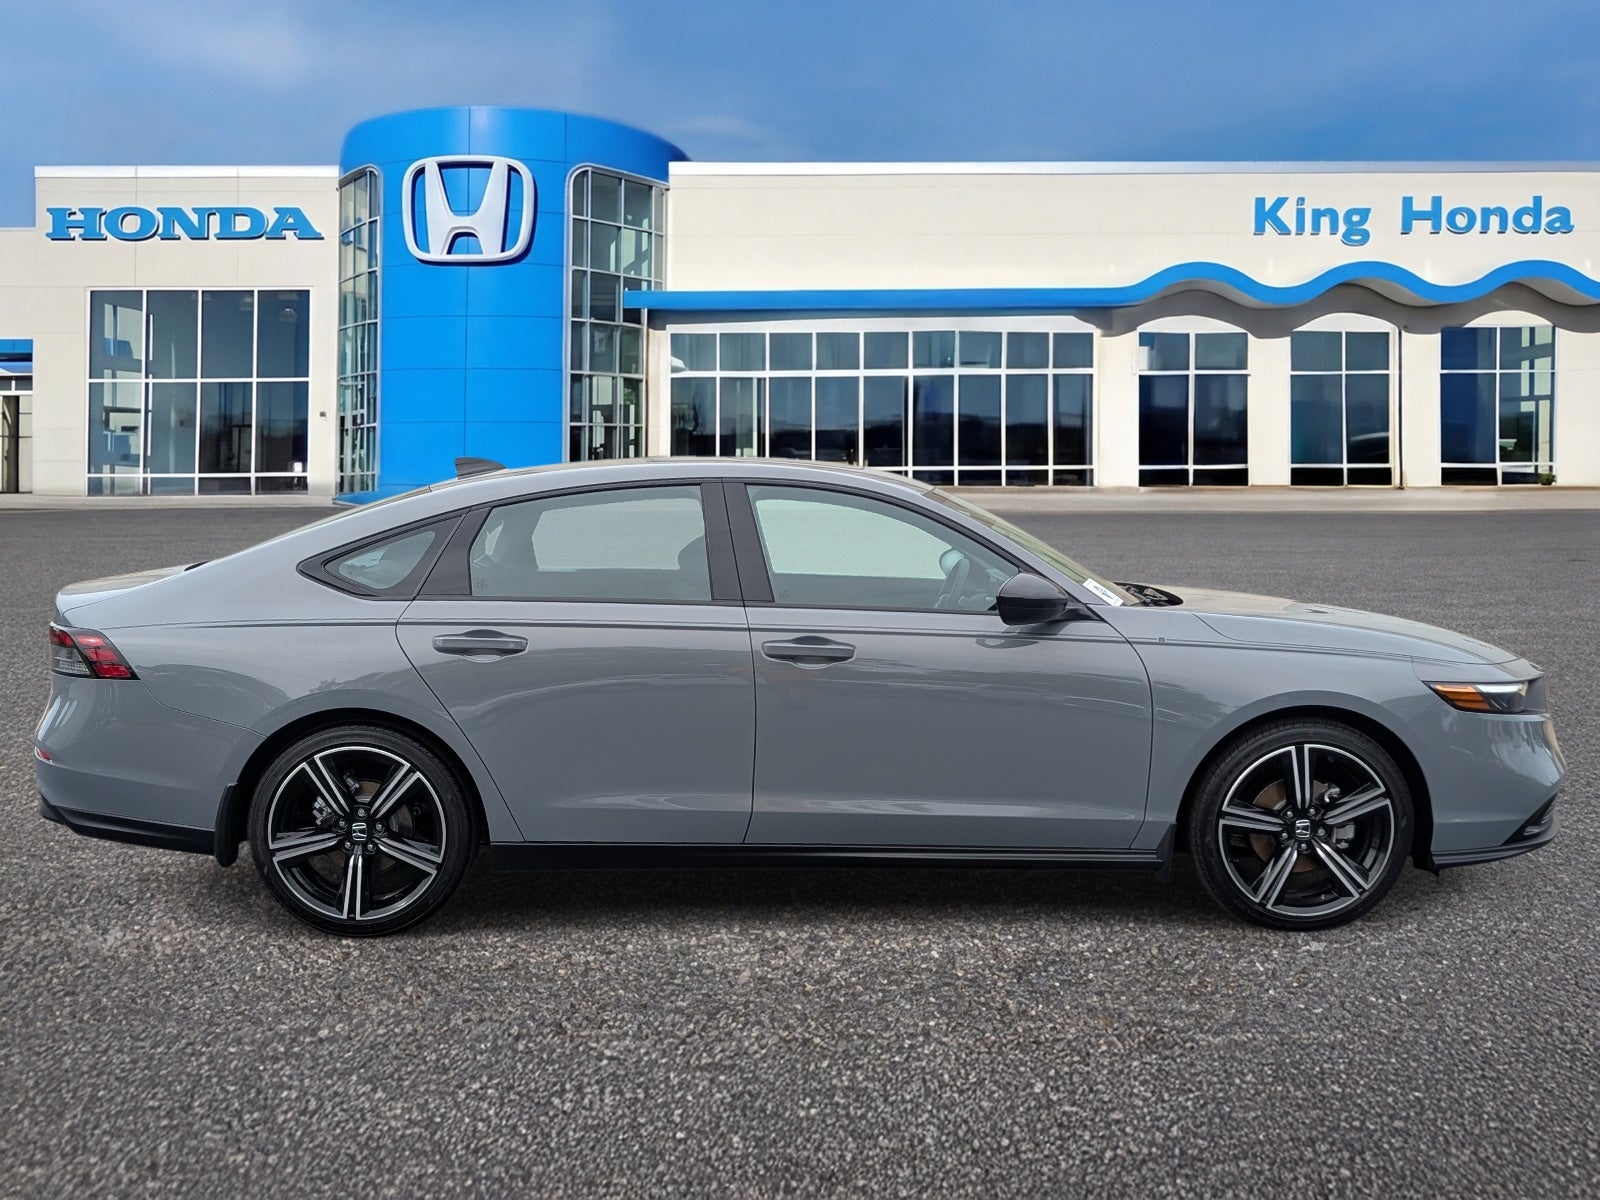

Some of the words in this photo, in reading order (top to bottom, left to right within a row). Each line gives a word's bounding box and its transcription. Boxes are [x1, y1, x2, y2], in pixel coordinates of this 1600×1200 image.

[46, 206, 324, 241] HONDA
[1253, 195, 1371, 246] King
[1401, 195, 1574, 234] Honda
